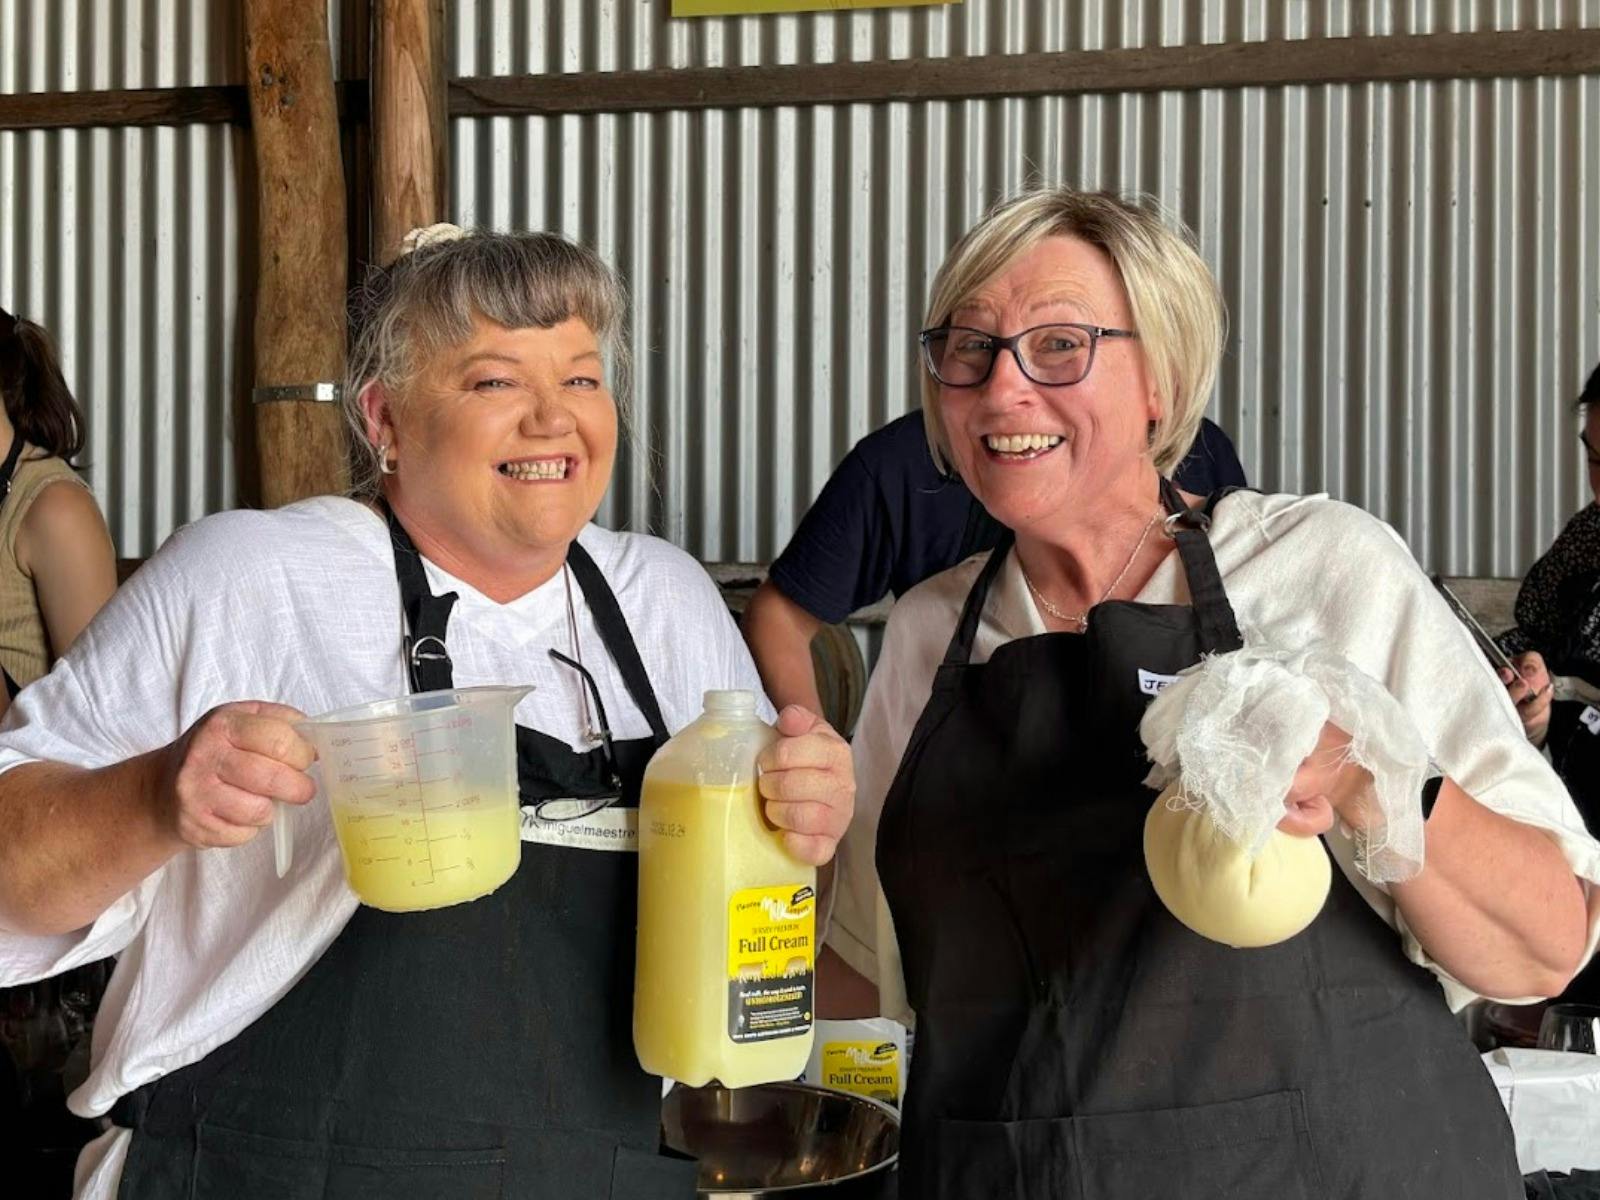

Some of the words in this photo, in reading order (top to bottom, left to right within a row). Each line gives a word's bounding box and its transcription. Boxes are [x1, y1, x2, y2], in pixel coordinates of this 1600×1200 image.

[739, 936, 766, 953] Full
[769, 935, 809, 951] Cream
[829, 1072, 851, 1085] Full
[854, 1072, 893, 1086] Cream
